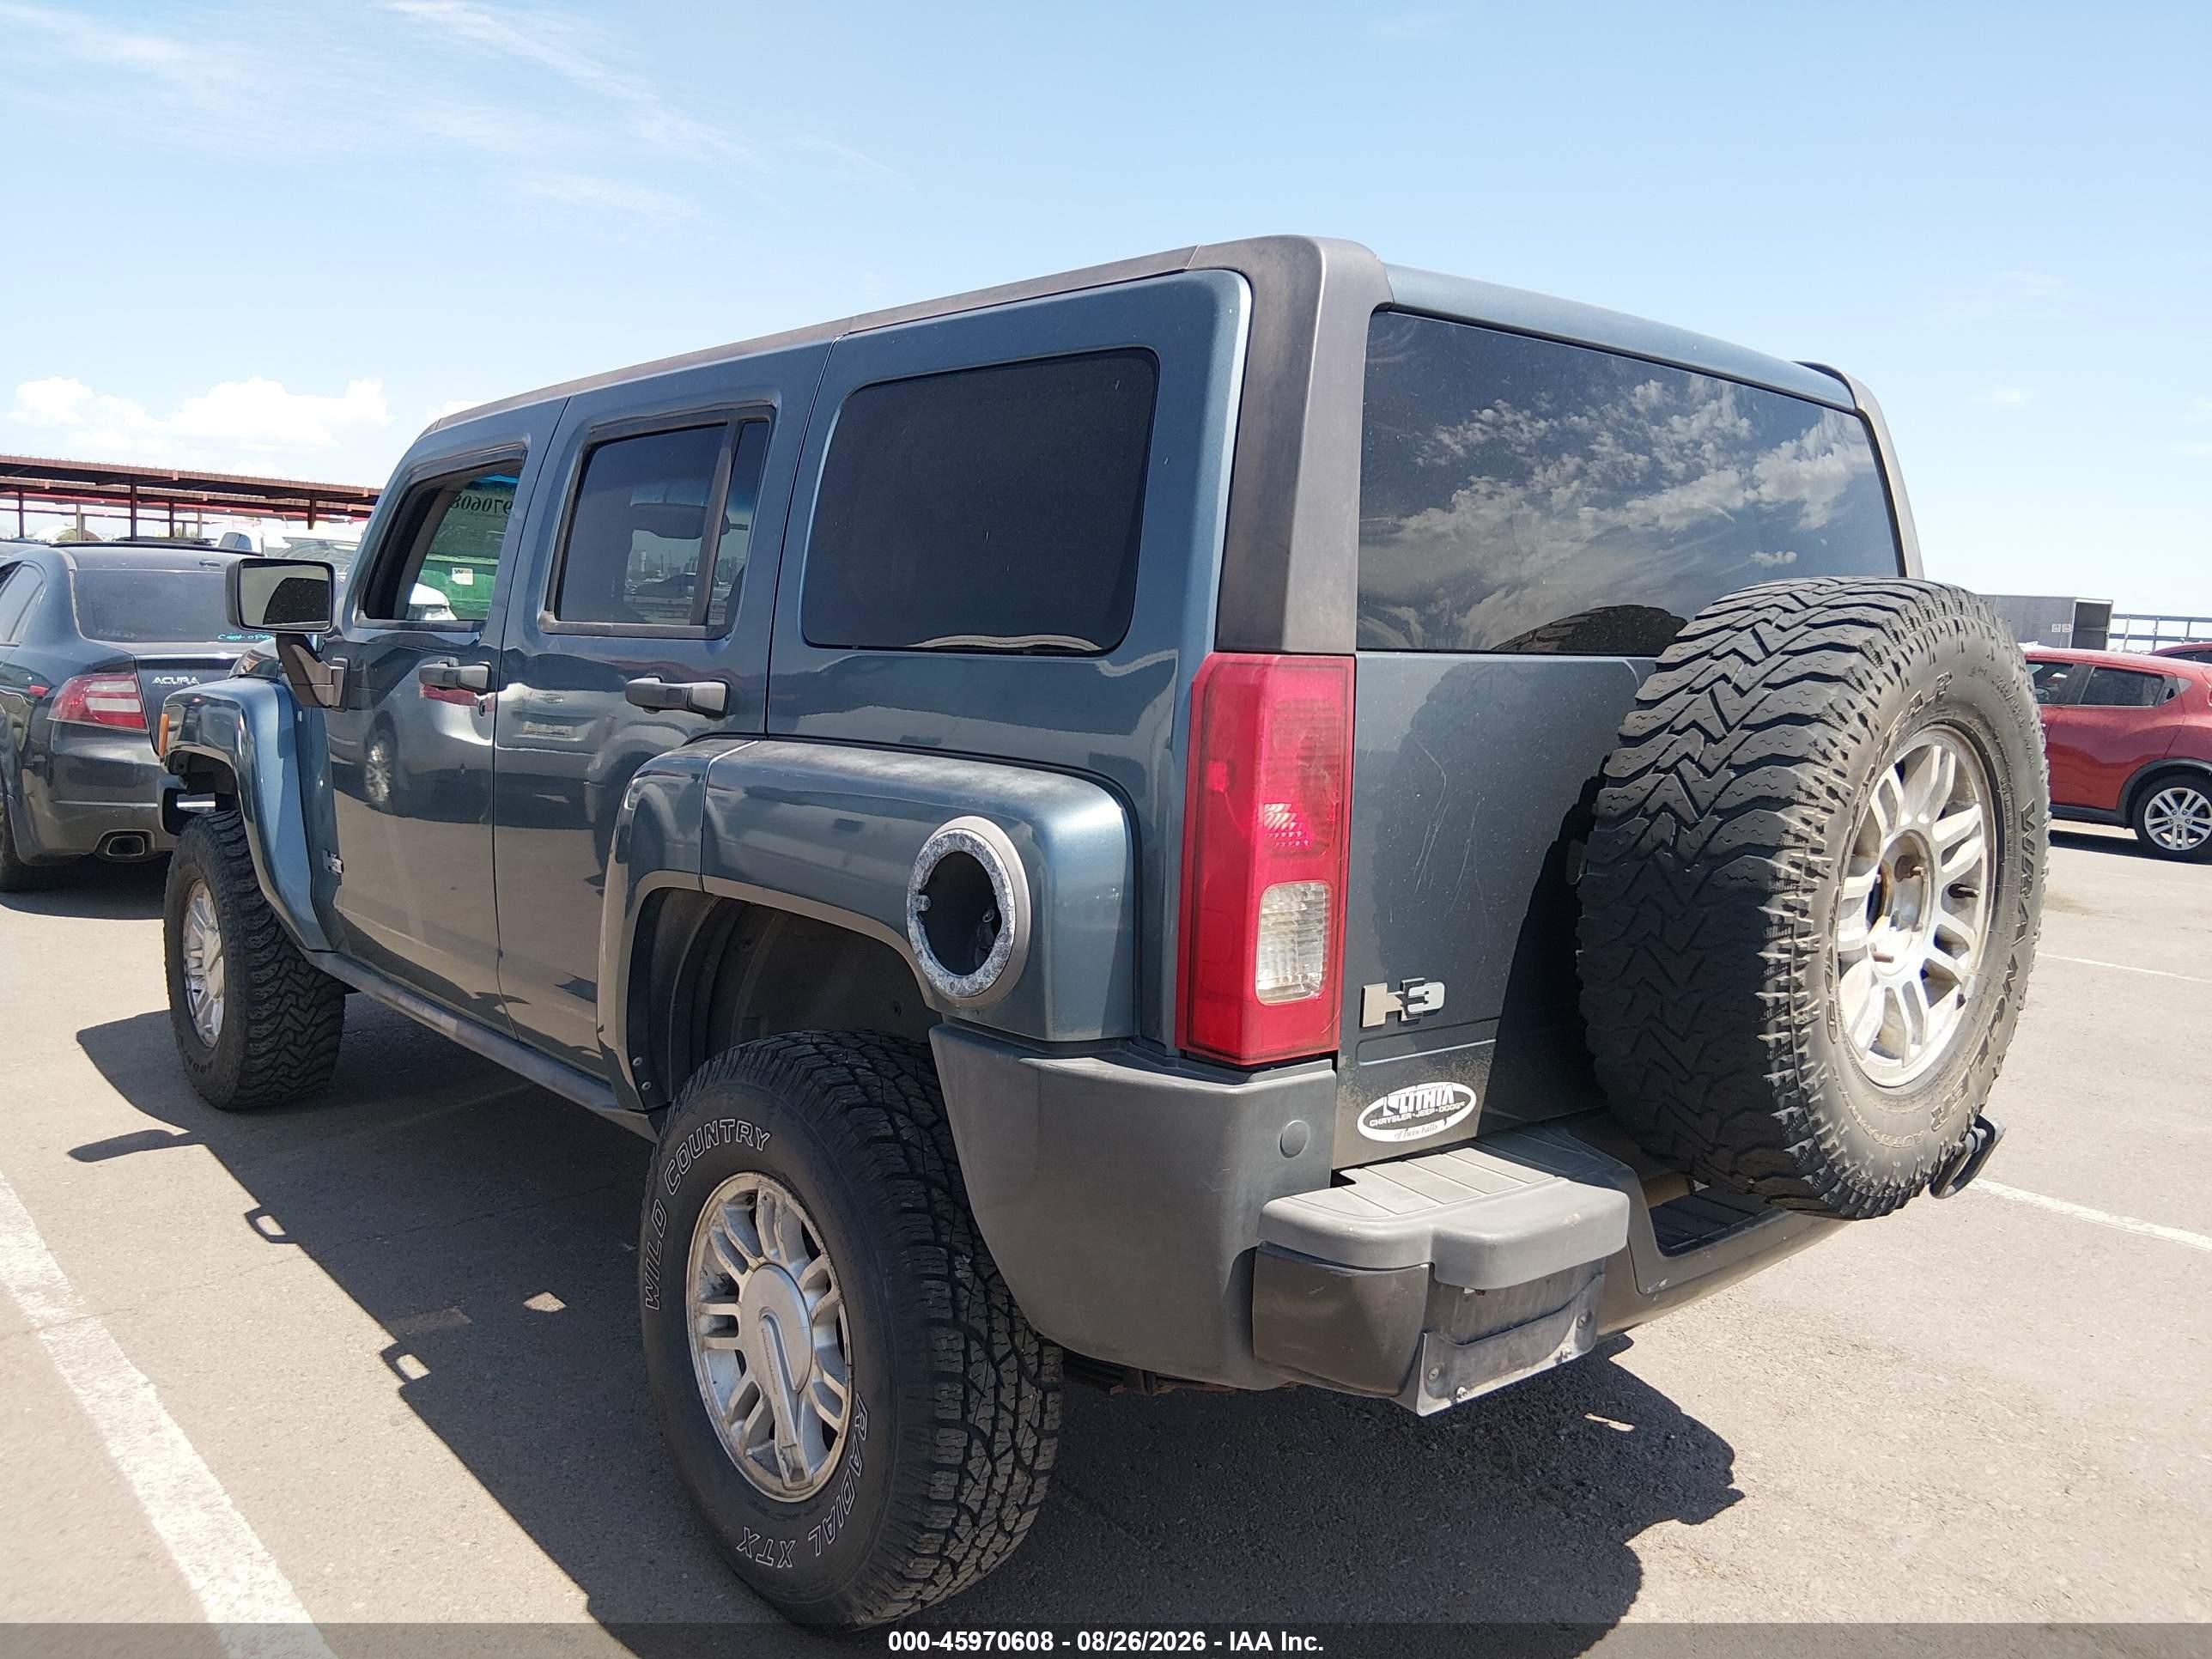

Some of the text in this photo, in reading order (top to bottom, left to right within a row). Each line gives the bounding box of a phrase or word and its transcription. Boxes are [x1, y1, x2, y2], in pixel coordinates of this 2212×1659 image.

[151, 676, 200, 685] ACURA
[1930, 798, 2036, 1133] WRANGLER
[1359, 977, 1445, 1028] H3
[1369, 1112, 1413, 1127] CHRYSLER
[1415, 1108, 1436, 1119] JEEP
[1396, 1083, 1455, 1115] LITHIA
[645, 1118, 771, 1311] WILD COUNTRY
[736, 1392, 868, 1569] RADIAL XTX
